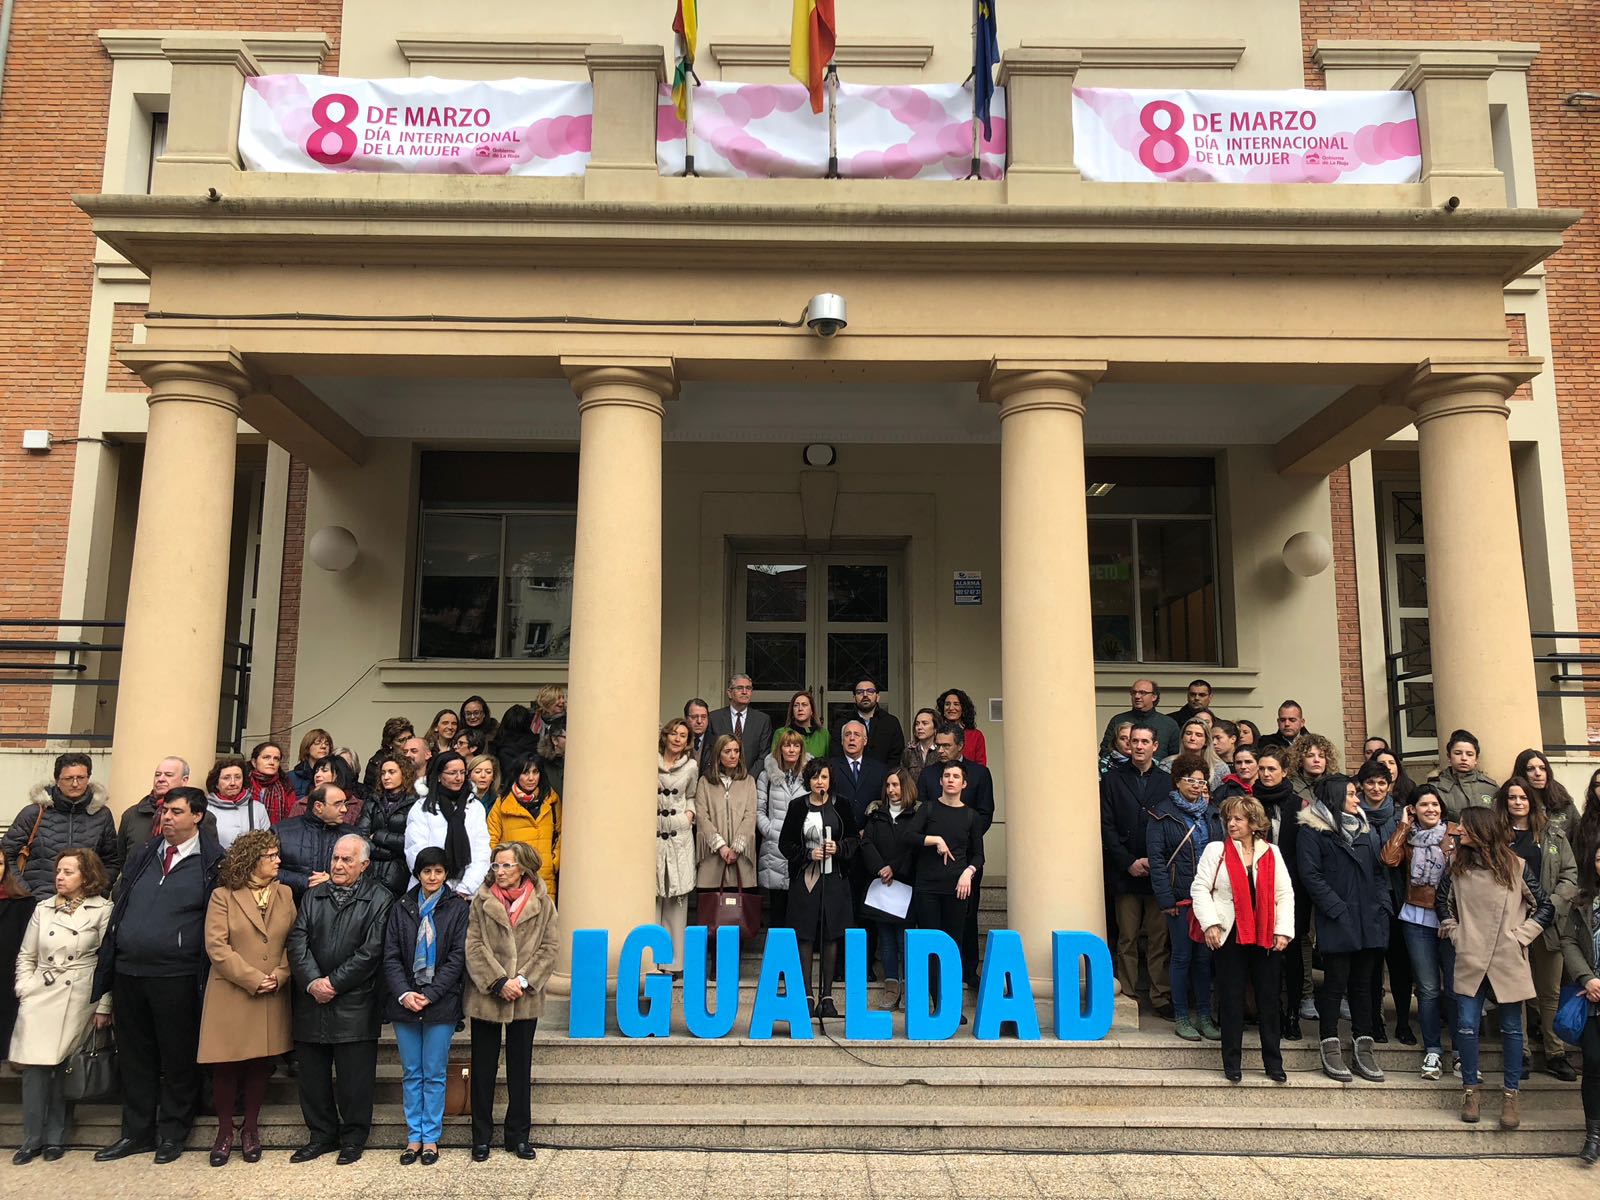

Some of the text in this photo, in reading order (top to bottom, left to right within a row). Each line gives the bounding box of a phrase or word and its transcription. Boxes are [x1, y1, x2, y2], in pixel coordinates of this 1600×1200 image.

[366, 105, 491, 127] DE MARZO
[1193, 110, 1317, 132] DE MARZO
[306, 93, 359, 165] 8
[364, 127, 521, 144] DÍA INTERNACIONAL
[1138, 99, 1190, 173] 8
[363, 143, 460, 157] DE LA MUJER
[1195, 134, 1348, 150] DÍA INTERNACIONAL
[1196, 150, 1290, 166] DE LA MUJER
[568, 924, 1114, 1041] IGUALDAD
